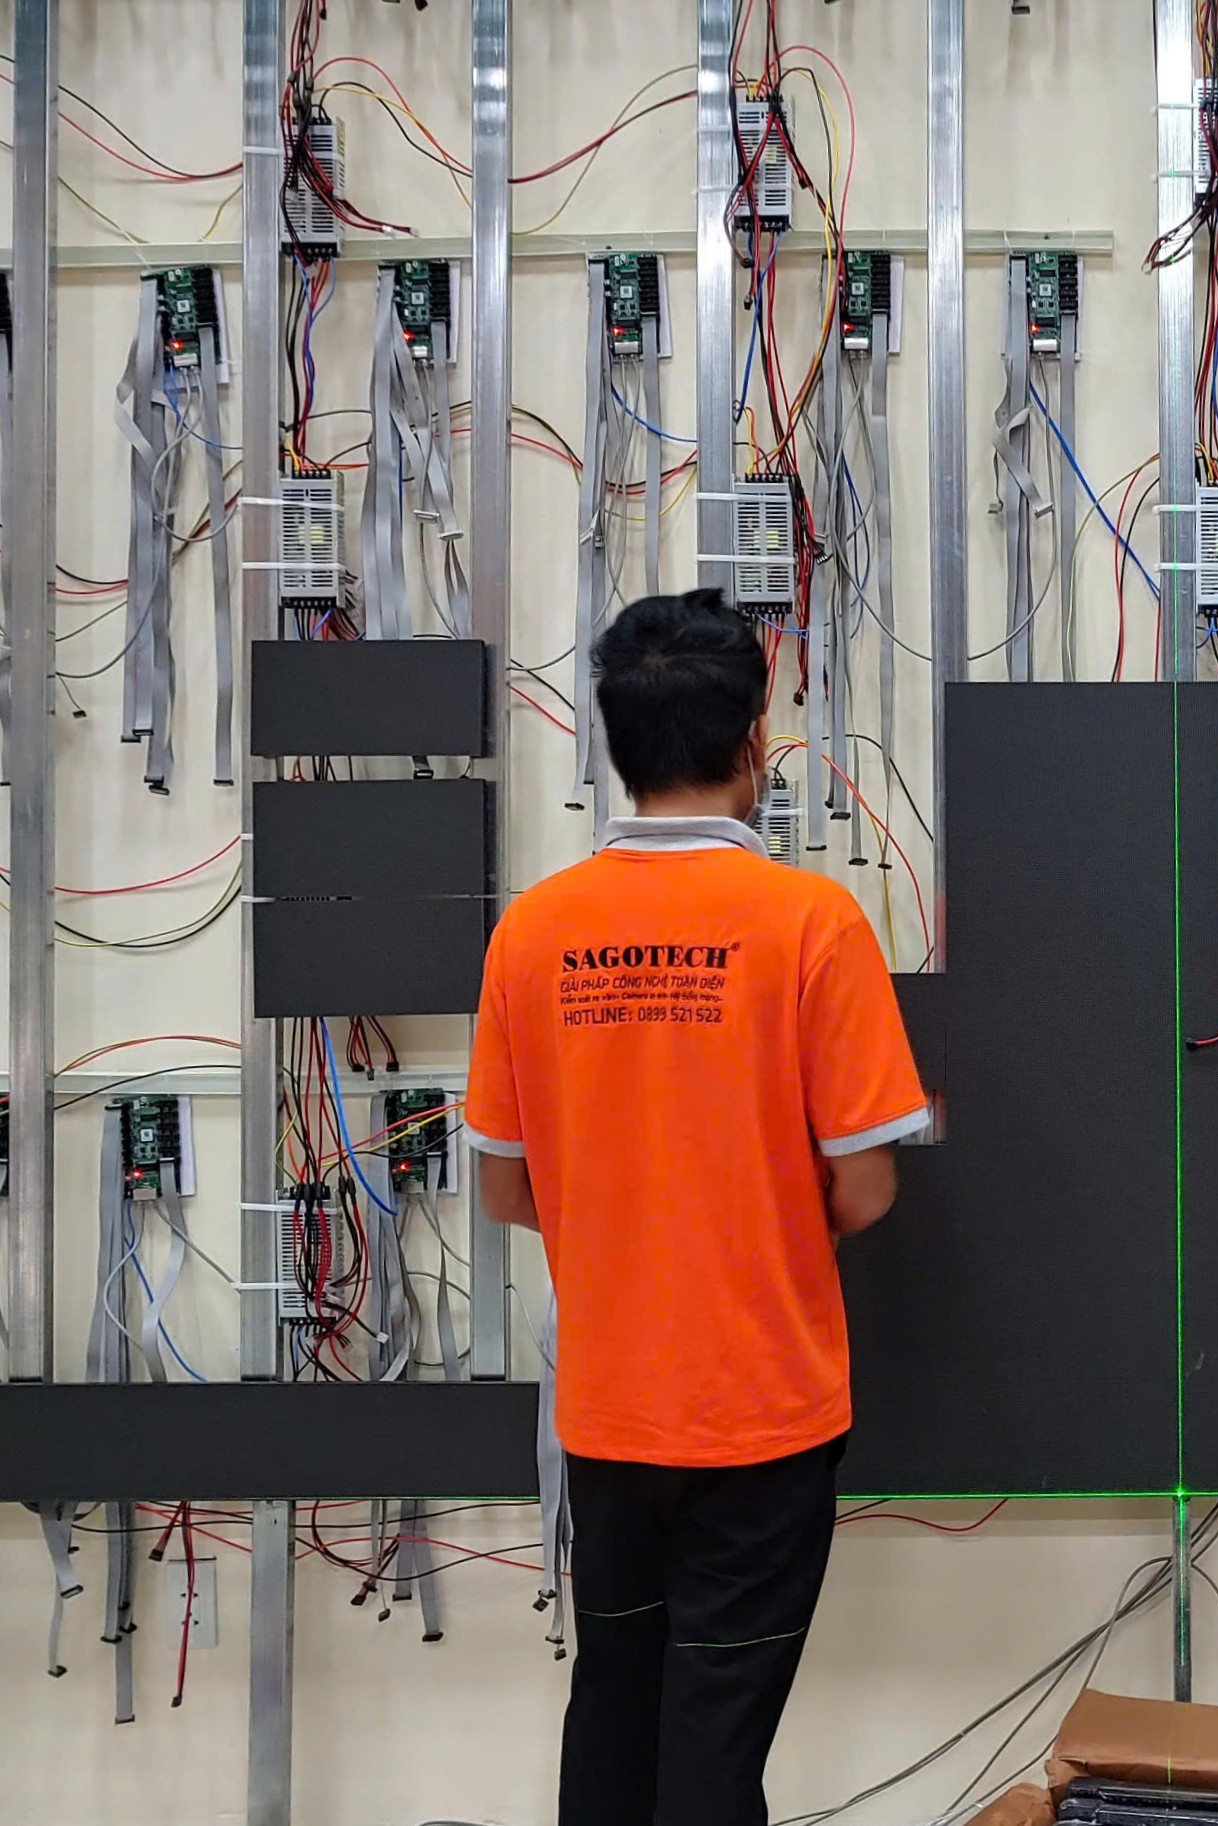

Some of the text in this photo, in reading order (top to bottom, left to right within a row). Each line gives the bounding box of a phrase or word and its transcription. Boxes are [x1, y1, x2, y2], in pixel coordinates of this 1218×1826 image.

[580, 975, 609, 991] PHÁP
[612, 973, 642, 989] CÔNG
[563, 1006, 722, 1027] HOTLINE: 0899 521 522
